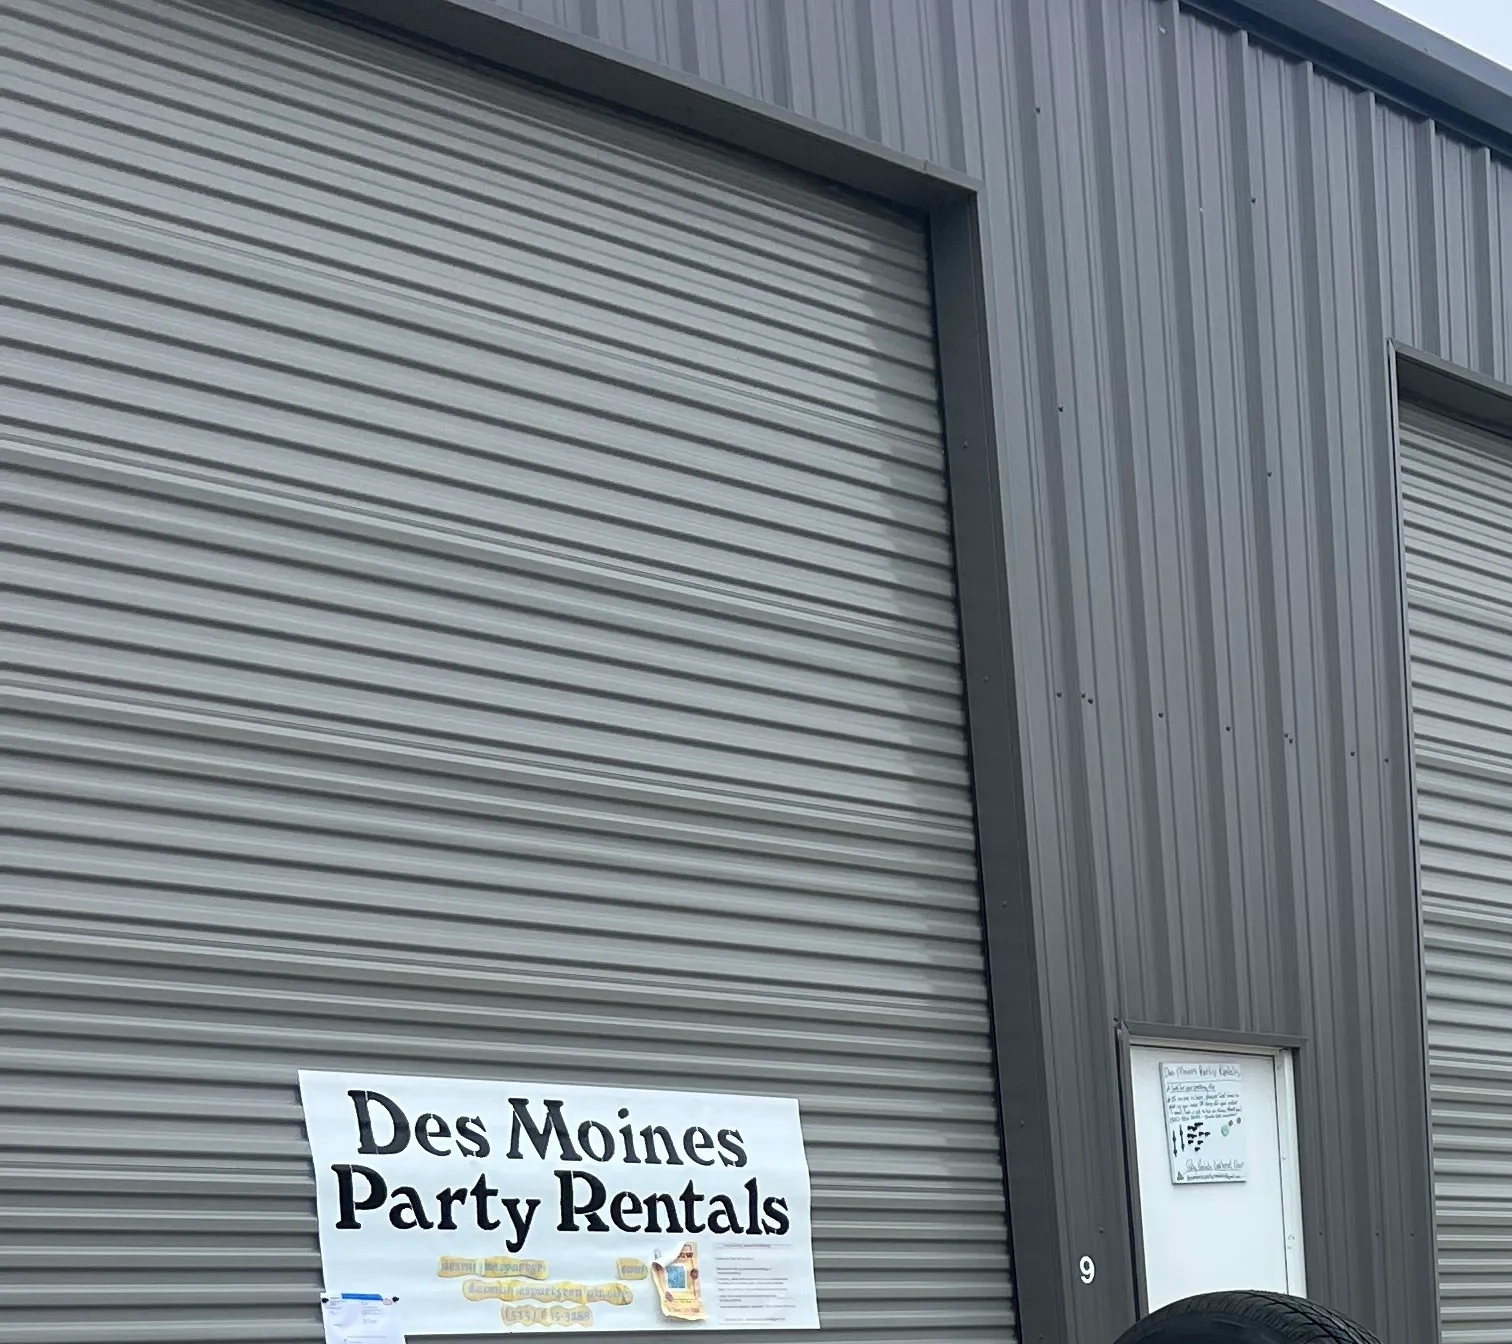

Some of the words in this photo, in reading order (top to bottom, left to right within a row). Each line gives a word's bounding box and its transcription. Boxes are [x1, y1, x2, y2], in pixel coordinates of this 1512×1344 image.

[347, 1089, 491, 1158] Des
[506, 1097, 749, 1168] Moines
[330, 1163, 542, 1254] Party
[553, 1169, 791, 1236] Rentals
[1079, 1255, 1095, 1284] 9
